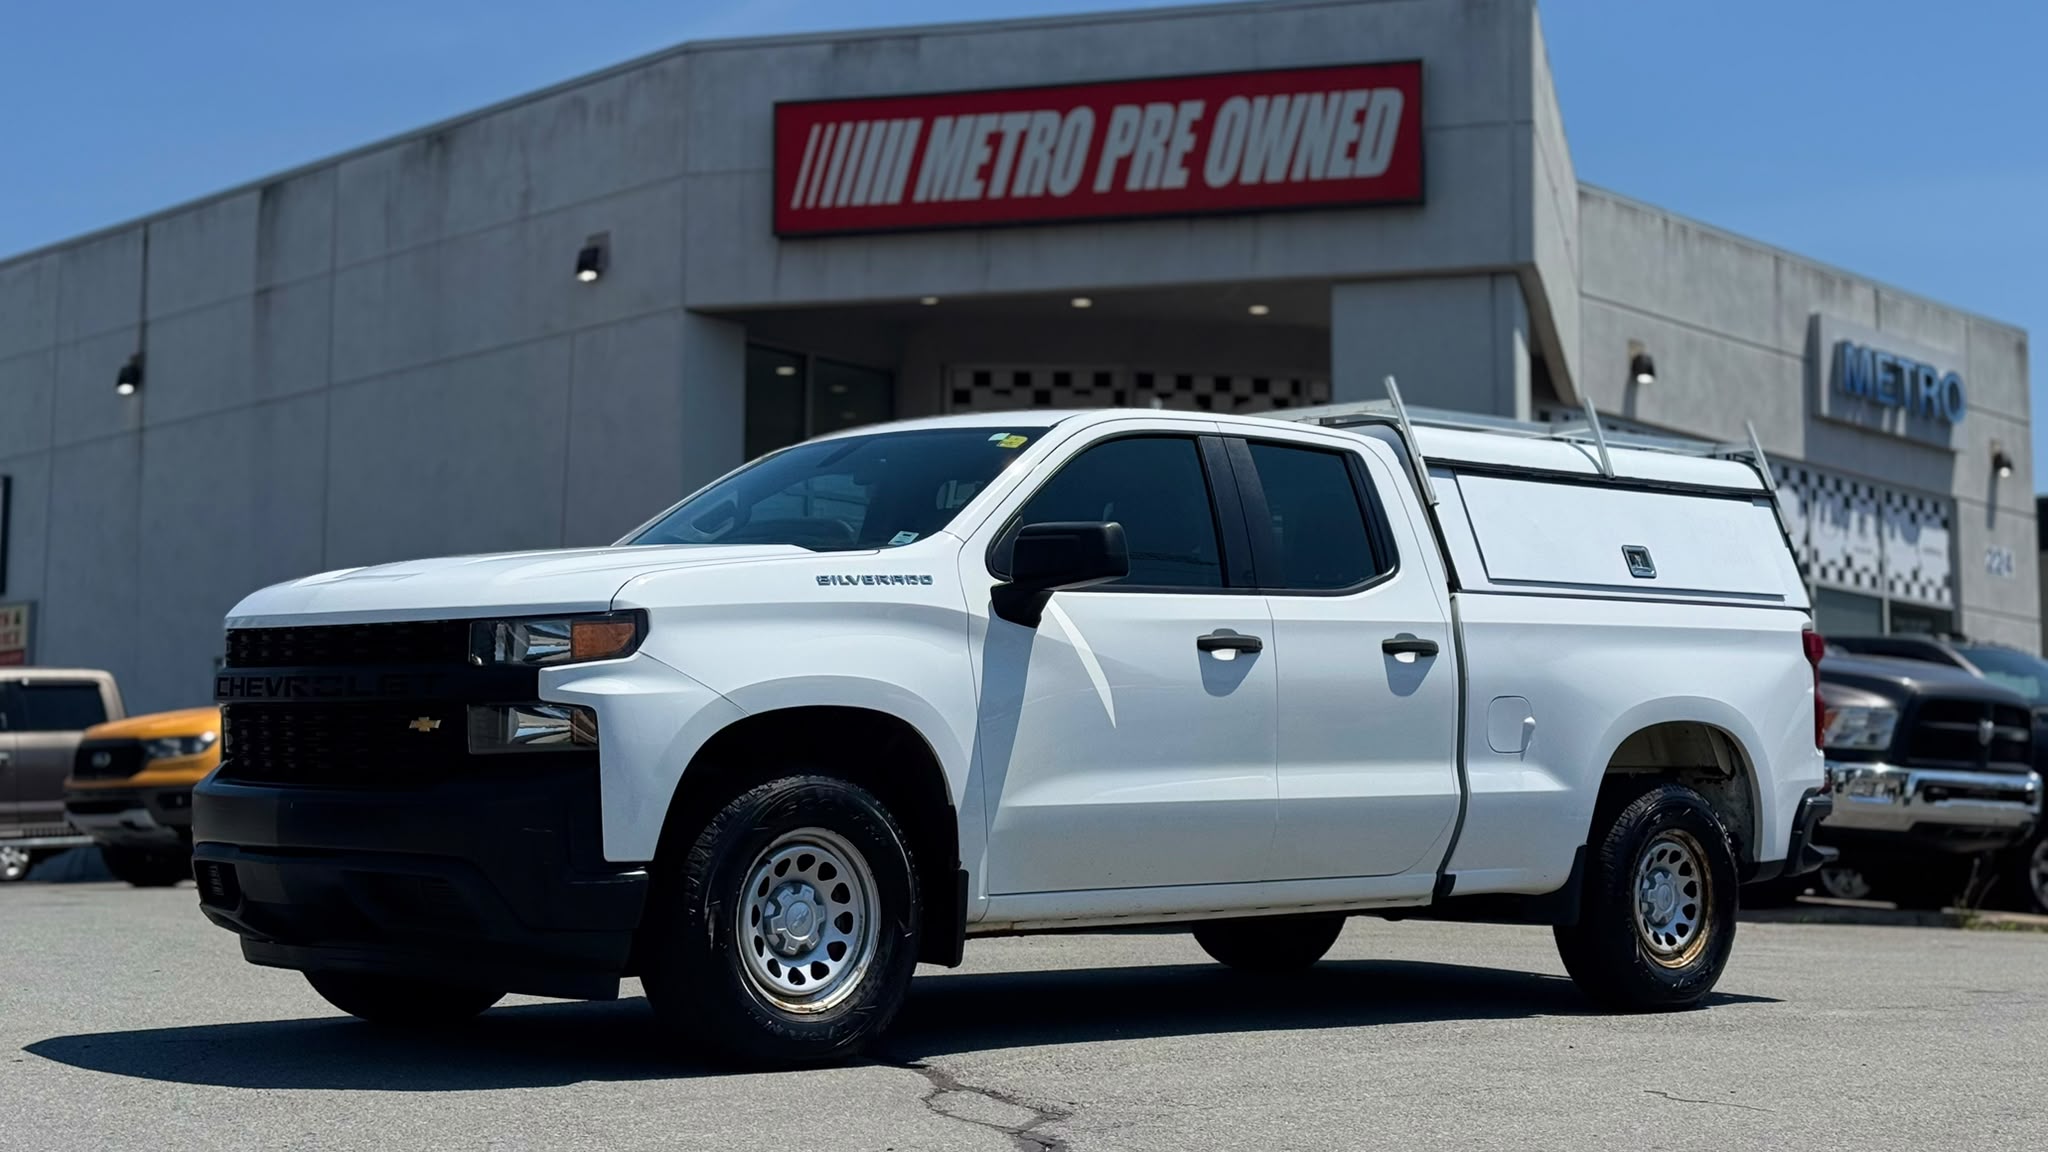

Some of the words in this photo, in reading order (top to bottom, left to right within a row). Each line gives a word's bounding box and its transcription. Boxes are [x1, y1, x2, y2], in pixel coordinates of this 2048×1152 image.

[913, 106, 1095, 203] METRO
[1094, 101, 1204, 193] PRE
[1205, 87, 1404, 188] OWNED
[1838, 342, 1967, 425] METRO
[816, 574, 933, 586] SILVERADO
